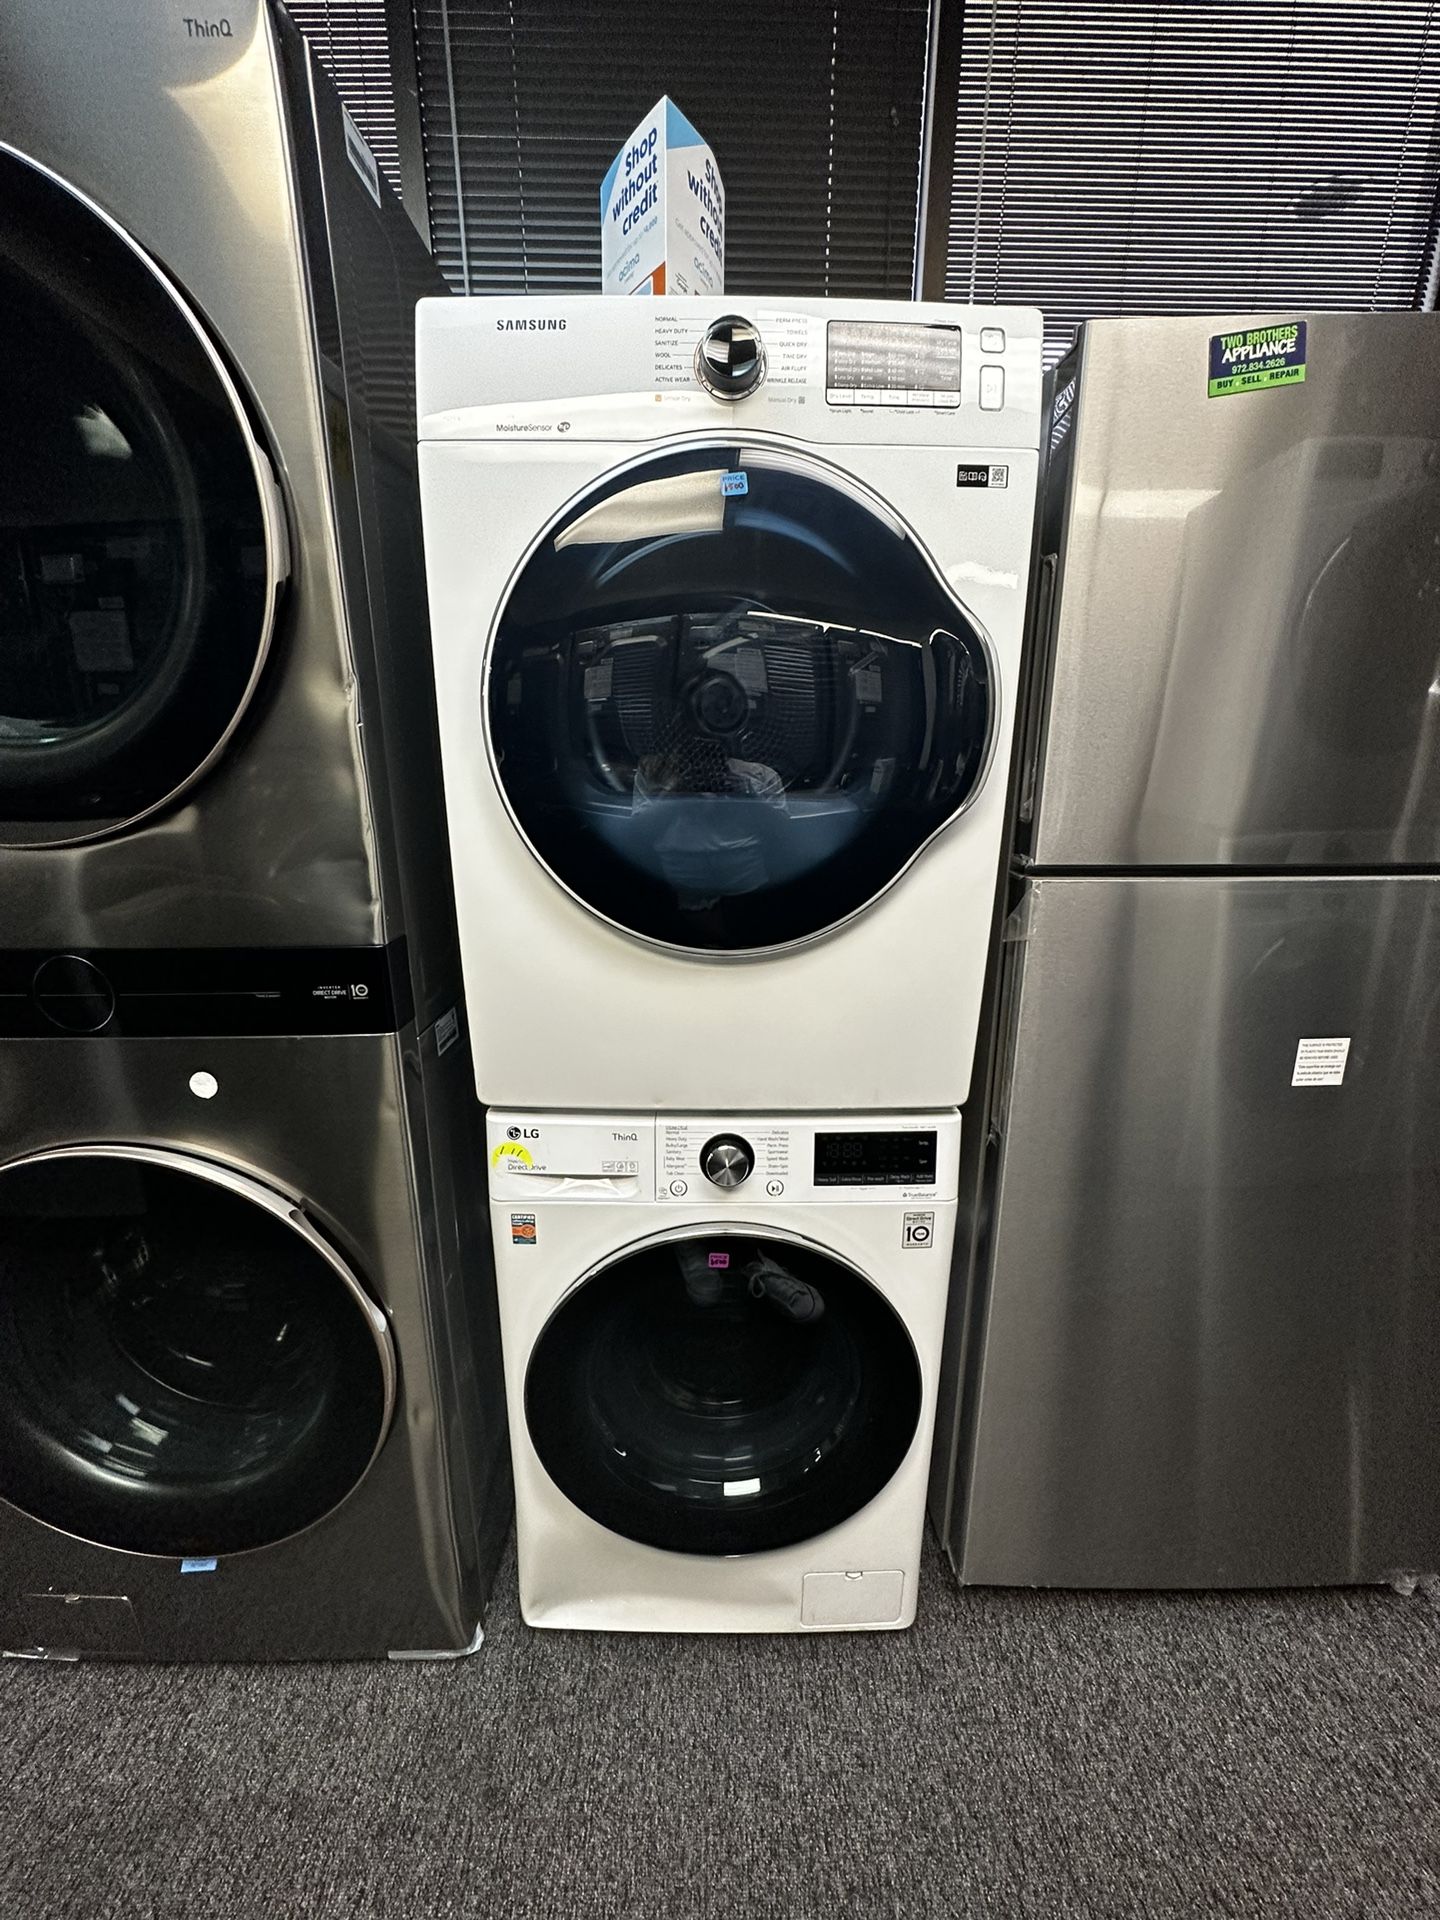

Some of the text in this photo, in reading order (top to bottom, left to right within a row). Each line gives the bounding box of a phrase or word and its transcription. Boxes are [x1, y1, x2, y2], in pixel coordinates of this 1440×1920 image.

[183, 18, 233, 37] ThinQ
[625, 127, 658, 177] Shop
[613, 154, 658, 222] without
[622, 185, 658, 236] credit
[496, 319, 567, 331] SAMSUNG
[1220, 325, 1299, 350] TWO BROTHERS
[1221, 338, 1297, 364] APPLIANCE
[1231, 357, 1286, 374] 972.834.2626
[1216, 368, 1300, 389] BUY SELL REPAIR
[496, 423, 552, 433] MoistureSensor
[351, 984, 369, 997] 10
[523, 1128, 540, 1139] LG
[612, 1132, 639, 1142] ThinQ
[906, 1226, 930, 1242] 10
